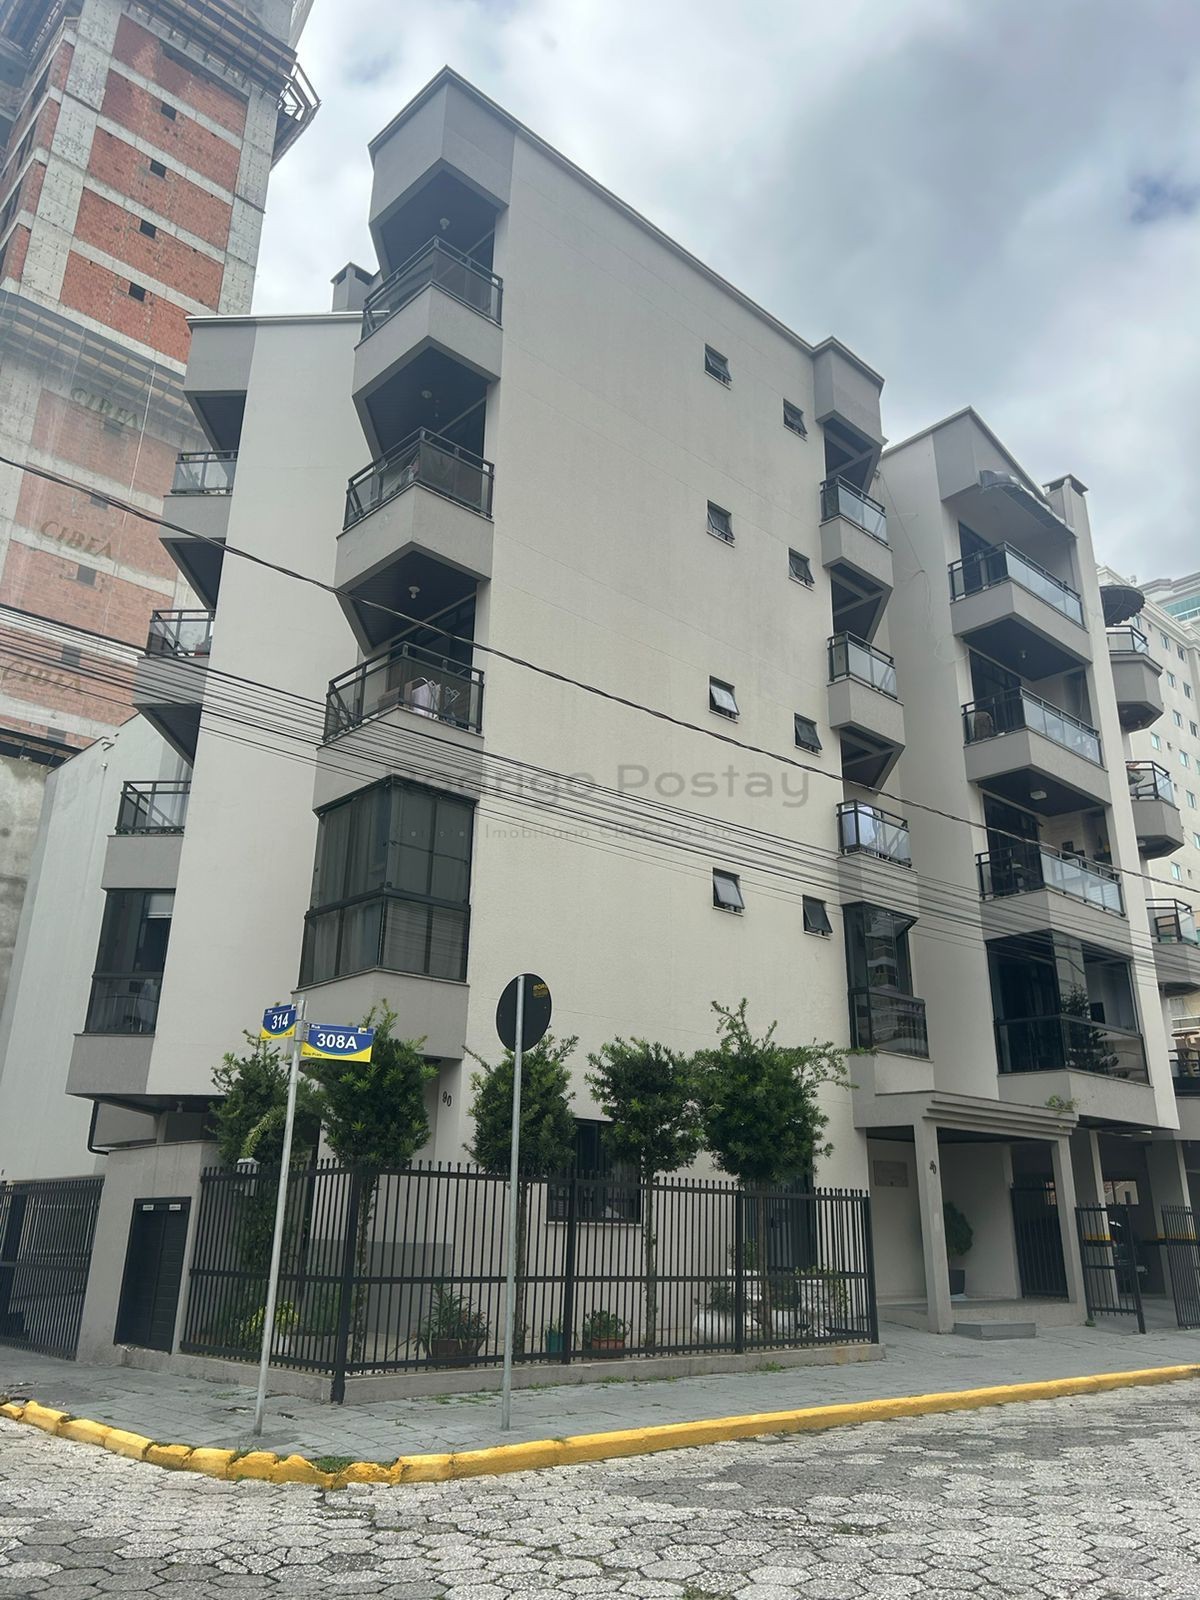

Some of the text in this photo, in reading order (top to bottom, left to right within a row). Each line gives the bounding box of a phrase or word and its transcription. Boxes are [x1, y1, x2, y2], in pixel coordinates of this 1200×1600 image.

[40, 521, 112, 560] CIBEA
[271, 1012, 289, 1030] 314
[316, 1033, 358, 1050] 308A
